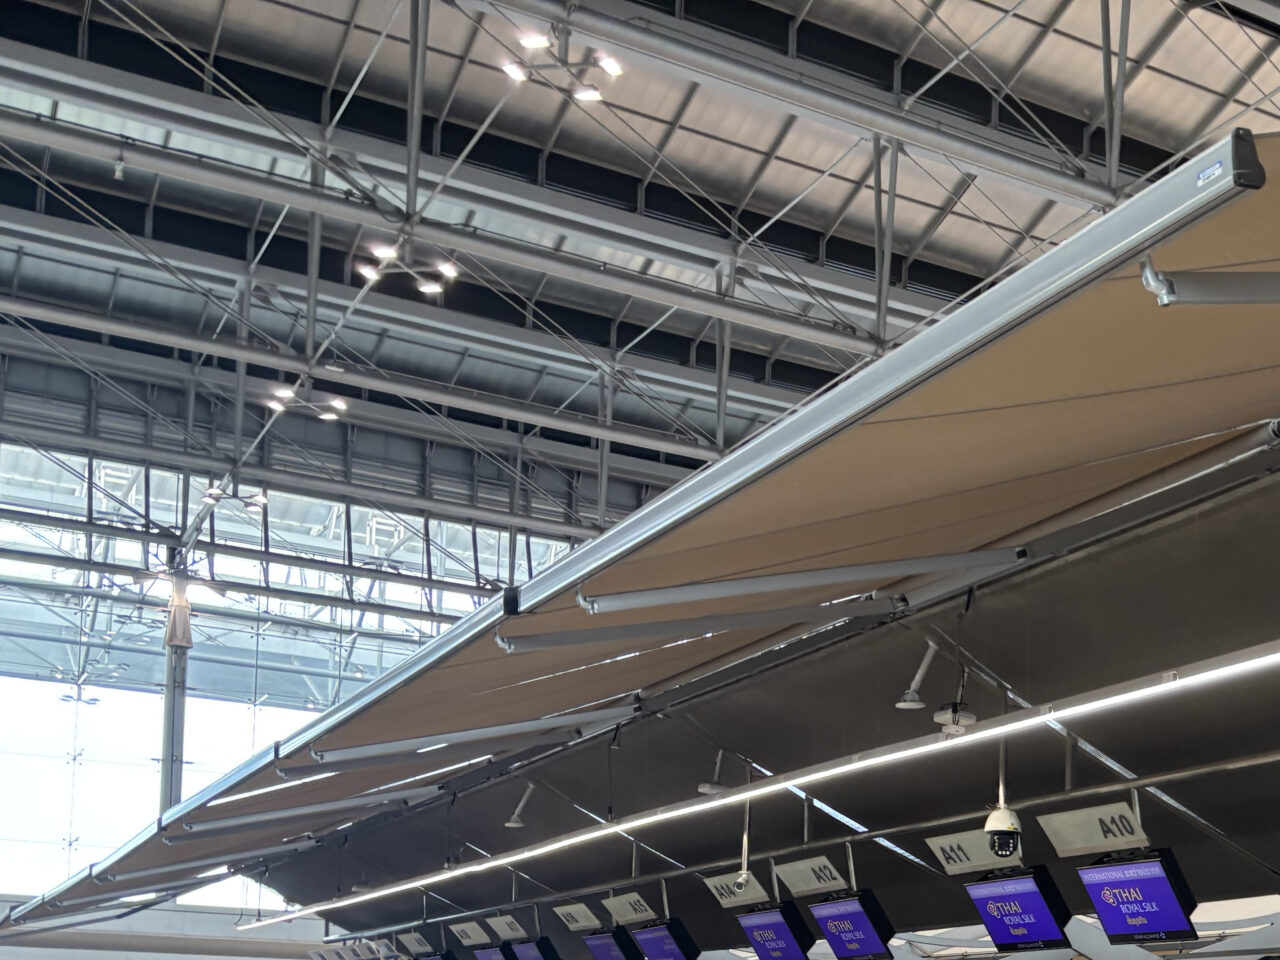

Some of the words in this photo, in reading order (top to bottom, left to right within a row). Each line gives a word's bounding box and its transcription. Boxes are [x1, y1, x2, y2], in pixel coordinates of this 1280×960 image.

[1098, 814, 1135, 839] A10
[940, 843, 970, 865] A11
[811, 865, 837, 884] A12
[714, 882, 736, 900] A14
[1113, 888, 1143, 902] THAI
[628, 899, 650, 915] A15
[996, 901, 1022, 915] THAI
